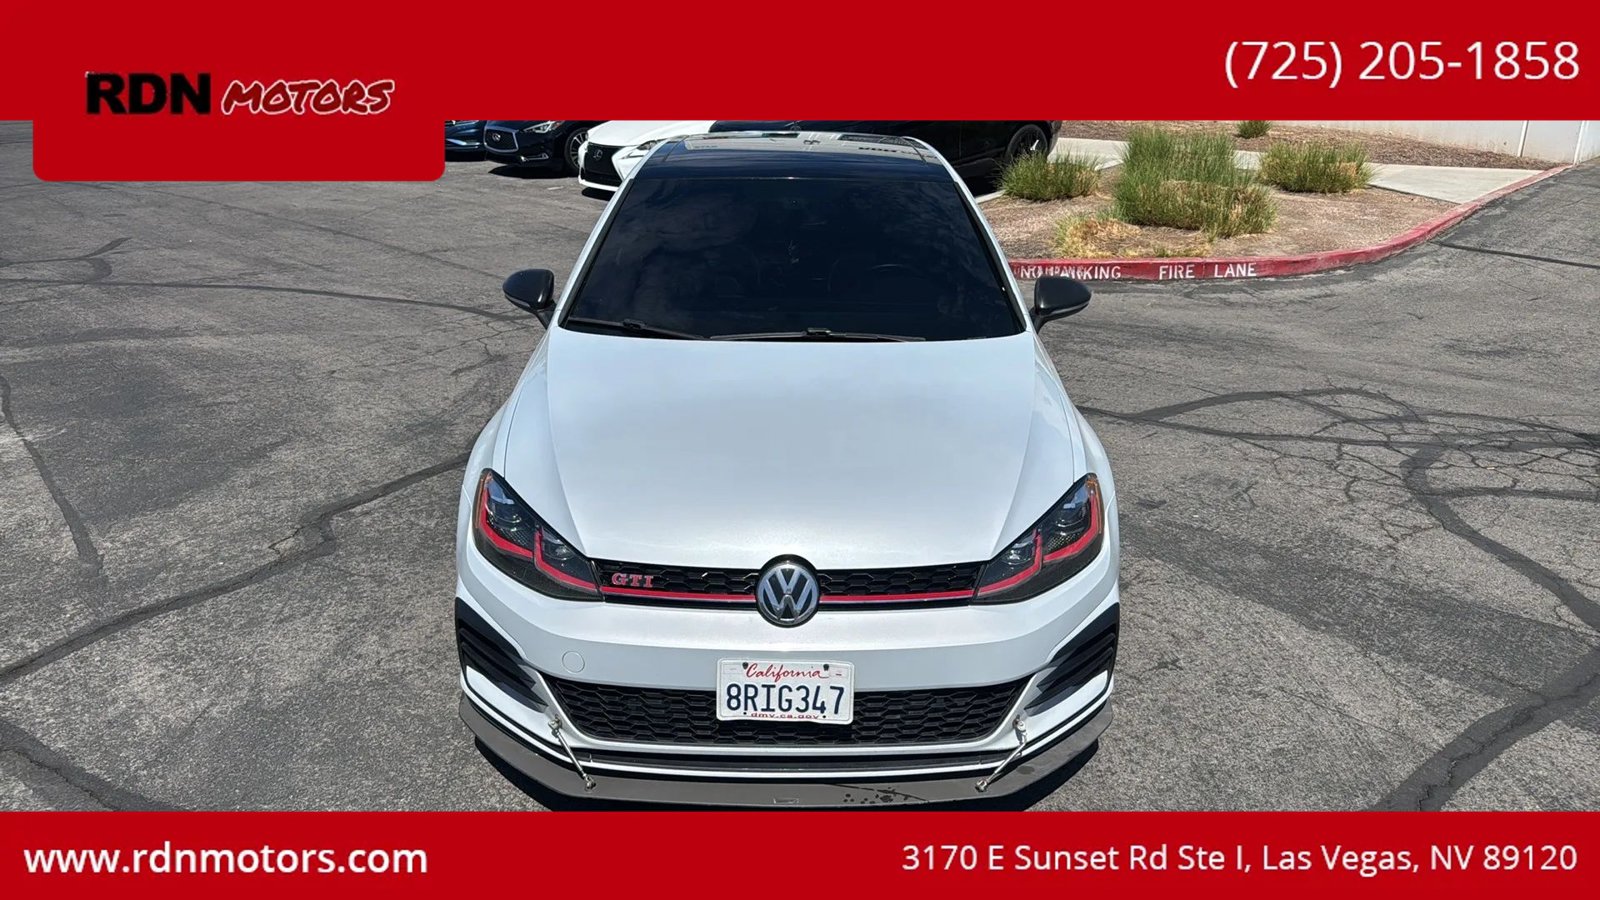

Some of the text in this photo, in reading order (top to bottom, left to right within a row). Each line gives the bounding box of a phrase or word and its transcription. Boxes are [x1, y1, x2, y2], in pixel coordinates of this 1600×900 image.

[1159, 264, 1196, 280] FIRE
[1214, 262, 1257, 278] LANE
[611, 572, 654, 588] GTI
[746, 662, 829, 682] California
[726, 683, 845, 715] 8RIG347
